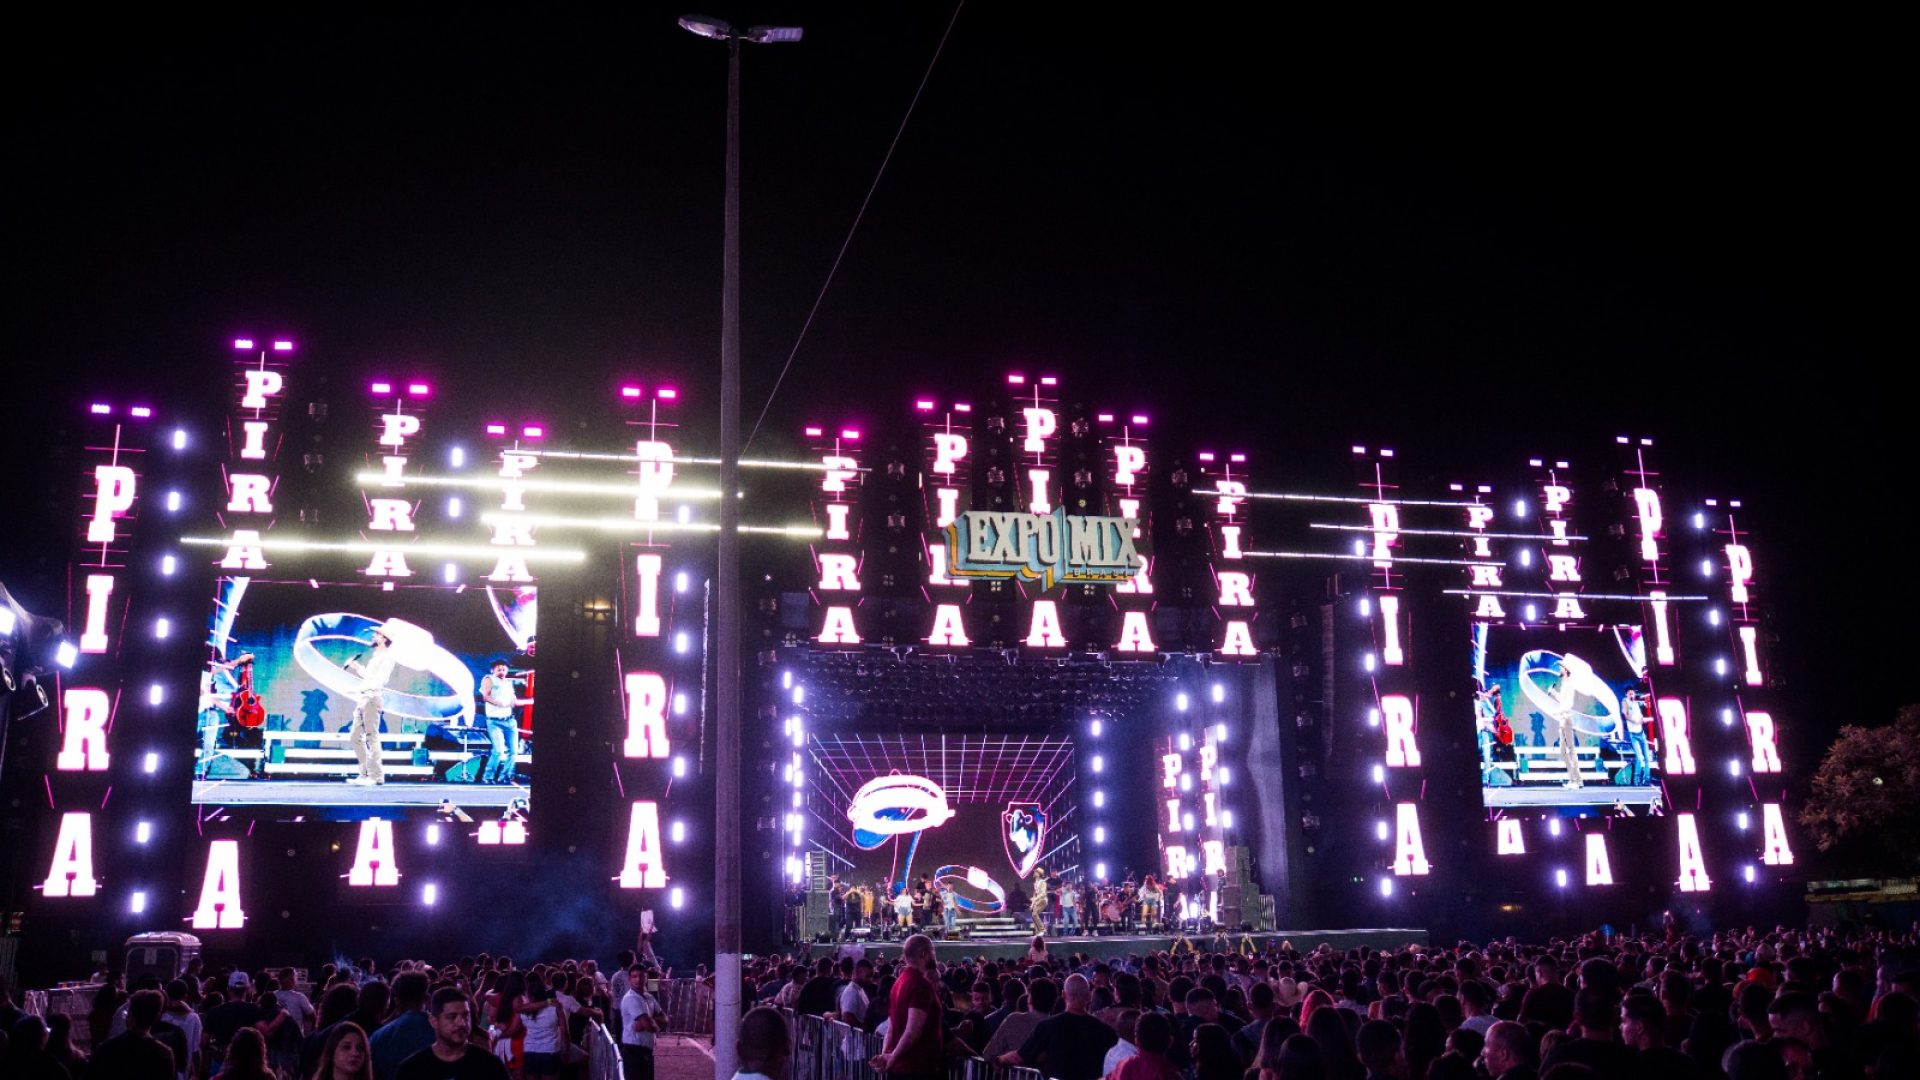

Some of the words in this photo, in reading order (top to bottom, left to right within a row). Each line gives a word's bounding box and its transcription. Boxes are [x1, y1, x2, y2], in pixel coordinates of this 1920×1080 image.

[221, 370, 282, 569] PIRA
[366, 414, 420, 576] PIRA
[488, 451, 537, 581] PIRA
[818, 455, 862, 644] PIRA
[967, 510, 1061, 564] EXPO
[1066, 514, 1143, 567] MIX
[1023, 407, 1067, 647] PIA
[1467, 506, 1505, 618] PIRA
[1544, 485, 1585, 618] PIRA
[620, 441, 675, 888] PIRA
[1216, 480, 1257, 655] PIRA
[43, 465, 136, 896] PIRA
[1369, 504, 1429, 875] PIRA
[1634, 488, 1710, 891] PIRA
[1725, 544, 1794, 865] PIRA
